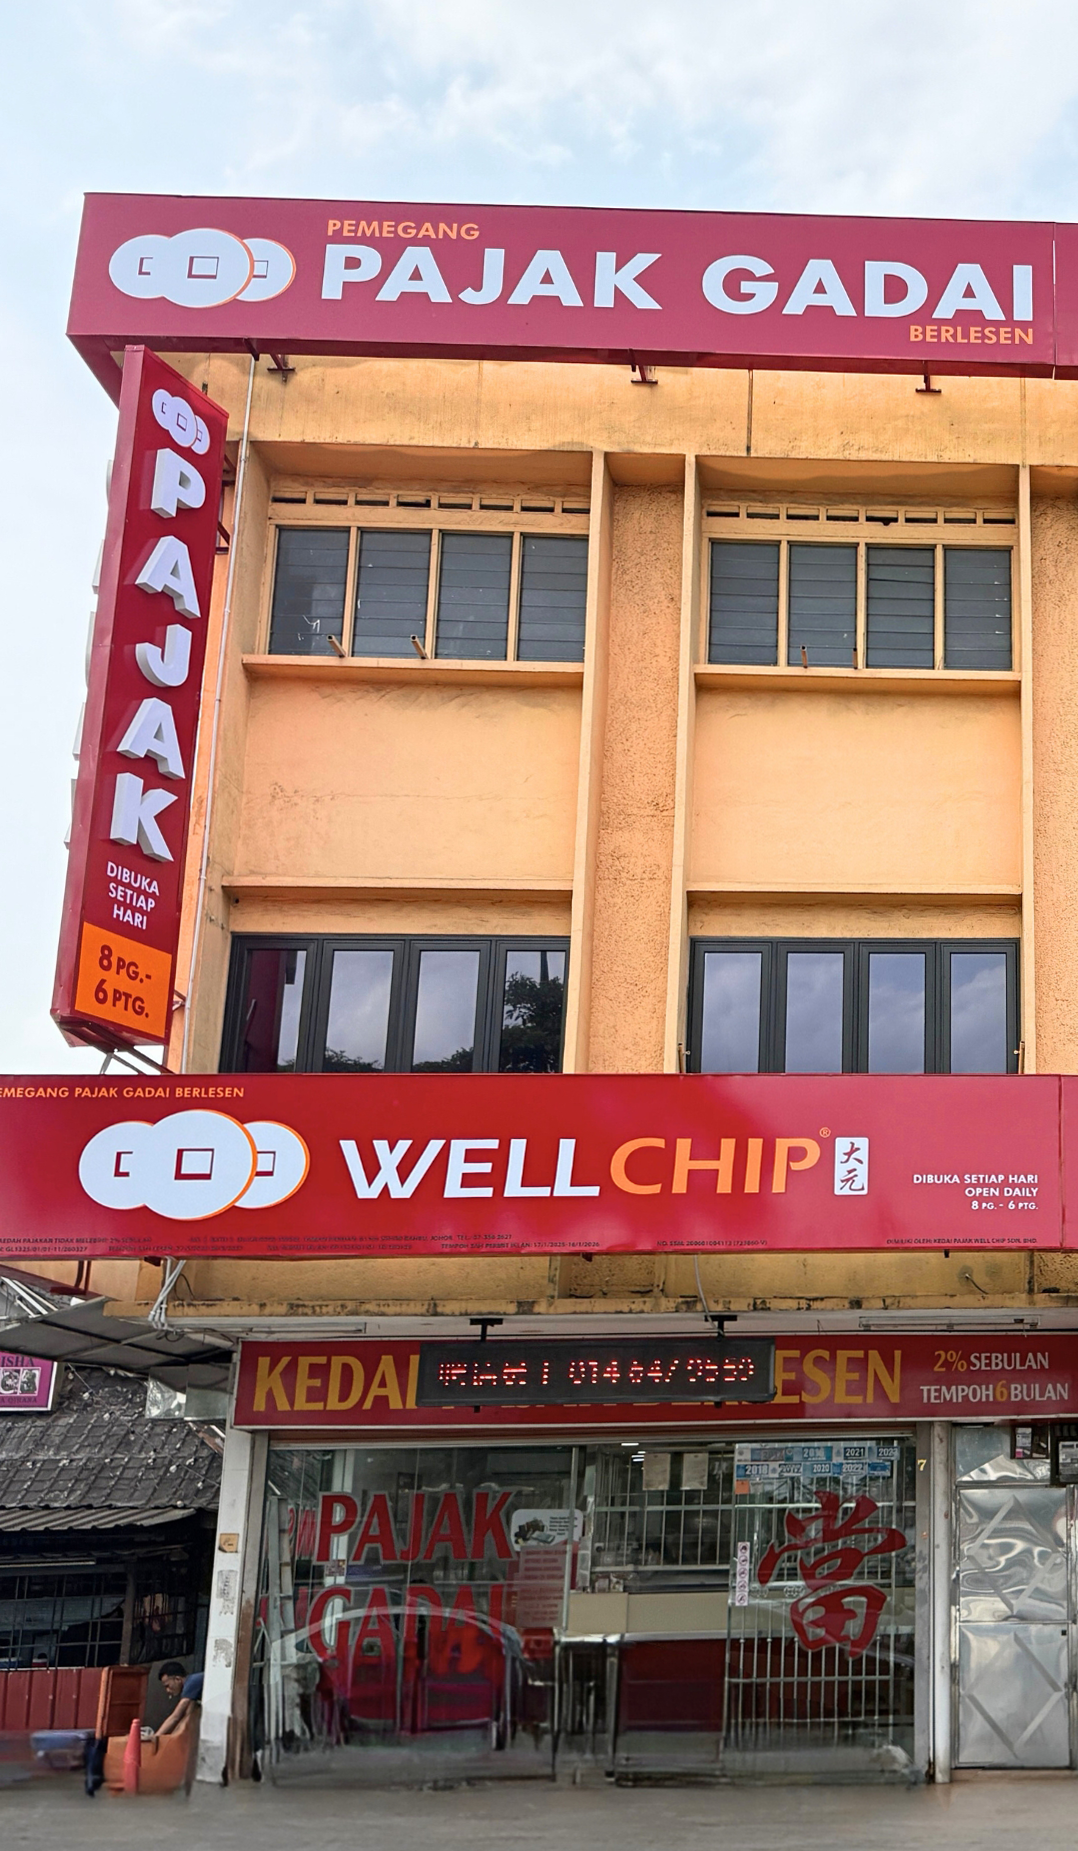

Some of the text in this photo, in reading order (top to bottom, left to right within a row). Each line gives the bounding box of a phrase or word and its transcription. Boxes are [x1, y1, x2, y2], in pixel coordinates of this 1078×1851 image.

[326, 218, 480, 242] PEMEGANG
[321, 243, 1034, 322] PAJAK GADAI
[909, 324, 1034, 345] BERLESEN
[110, 448, 206, 862] PAJAK
[107, 861, 159, 896] DIBUKA
[108, 882, 156, 912] SETIAP
[113, 907, 147, 930] HARI
[98, 944, 113, 972] 8
[94, 978, 149, 1018] 6 PTG.
[74, 1086, 118, 1098] PAJAK
[123, 1086, 170, 1098] GADAI
[175, 1086, 244, 1098] BERLESEN
[913, 1172, 1039, 1184] DIBUKA SETIAP HARI
[965, 1187, 1038, 1197] OPEN DAILY
[971, 1199, 980, 1210] 8
[1008, 1199, 1016, 1210] 6
[1018, 1200, 1039, 1210] PTG.
[933, 1350, 1049, 1373] 2% SEBULAN
[253, 1355, 420, 1413] KEDAI
[920, 1379, 1069, 1404] TEMPOH 6 BULAN
[845, 1447, 864, 1457] 2021
[917, 1459, 927, 1471] 7
[315, 1491, 516, 1564] PAJAK
